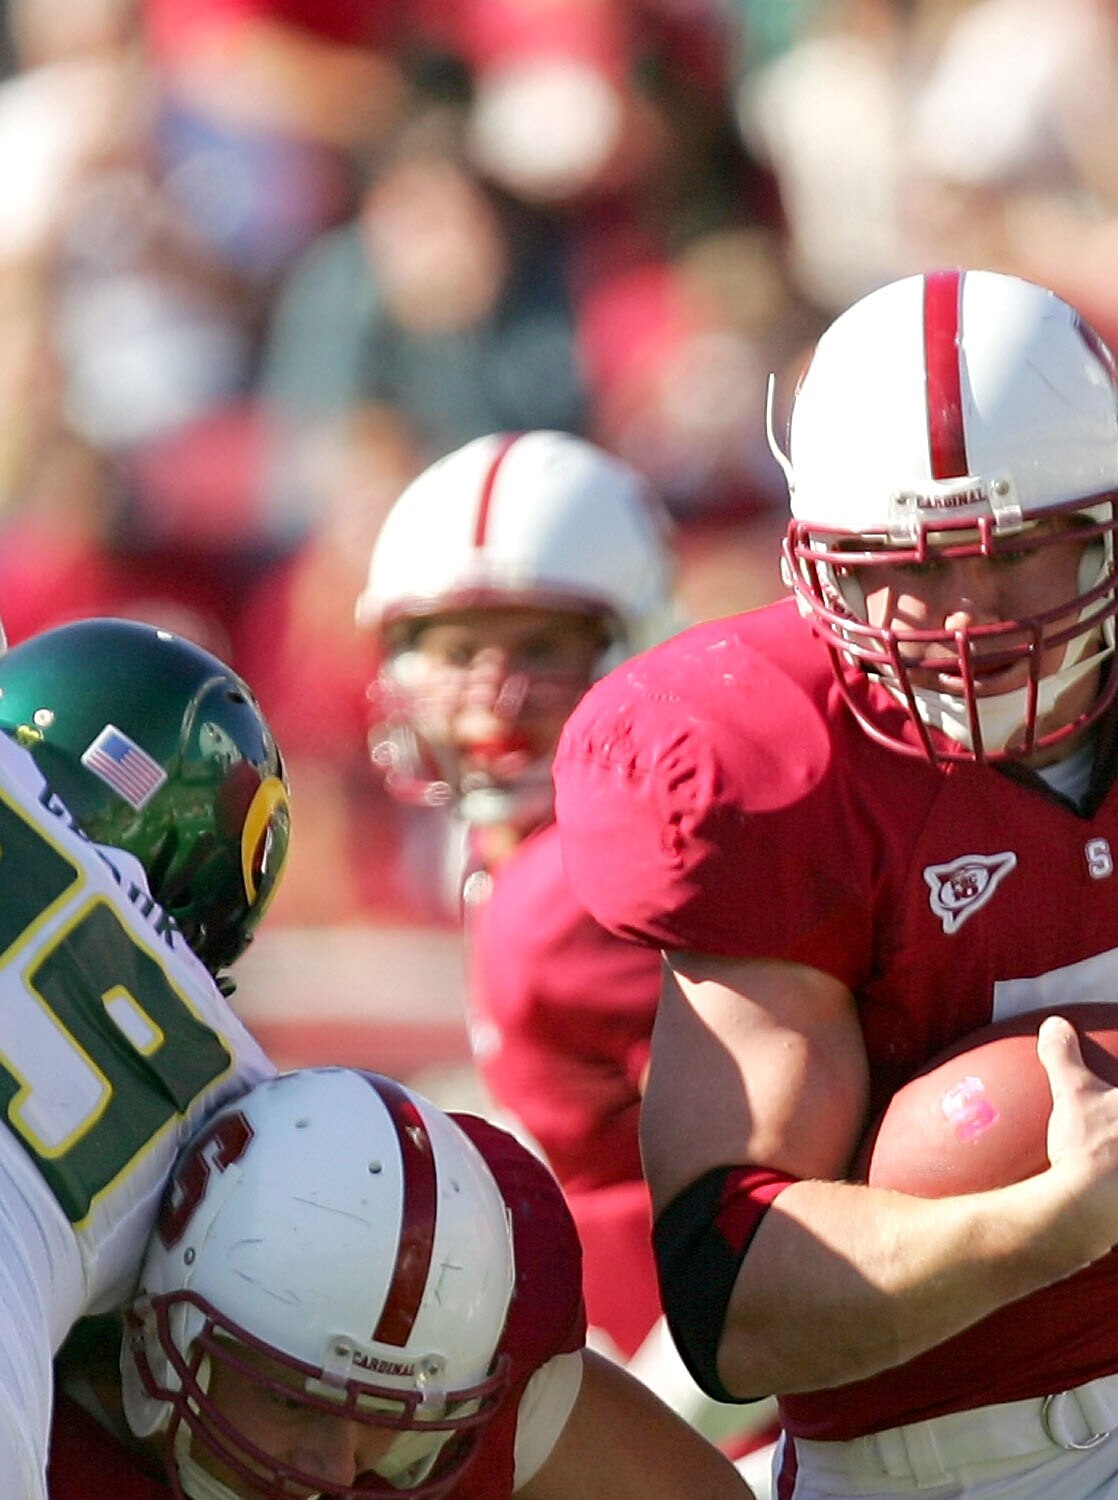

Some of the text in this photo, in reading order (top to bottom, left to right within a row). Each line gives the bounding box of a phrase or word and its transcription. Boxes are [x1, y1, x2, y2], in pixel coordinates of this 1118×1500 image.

[917, 487, 988, 509] CARDINAL
[1085, 838, 1113, 879] S
[352, 1349, 416, 1377] CARDINAL
